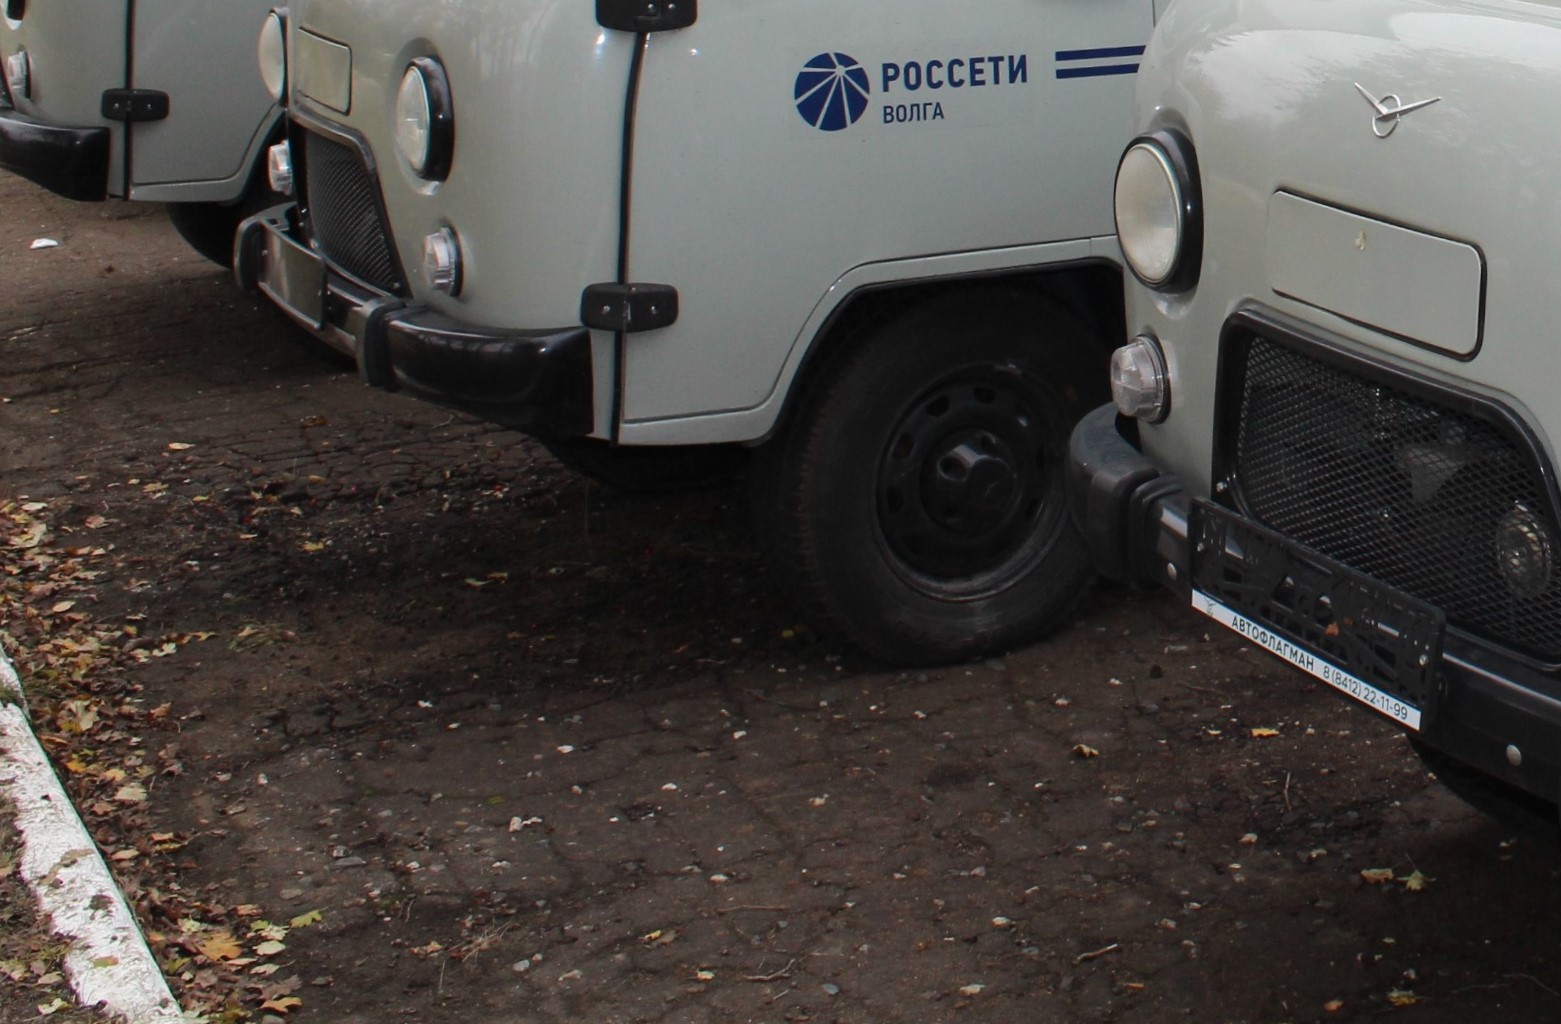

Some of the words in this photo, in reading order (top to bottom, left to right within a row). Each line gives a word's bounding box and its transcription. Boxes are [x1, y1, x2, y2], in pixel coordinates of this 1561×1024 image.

[881, 54, 1027, 93] РОССЕТИ
[883, 101, 945, 124] ВОЛГА
[1231, 616, 1315, 671] АВТОФЛАГМАН
[1322, 665, 1330, 679] 8
[1331, 668, 1361, 698] (8412)
[1363, 688, 1408, 720] 22-11-99
